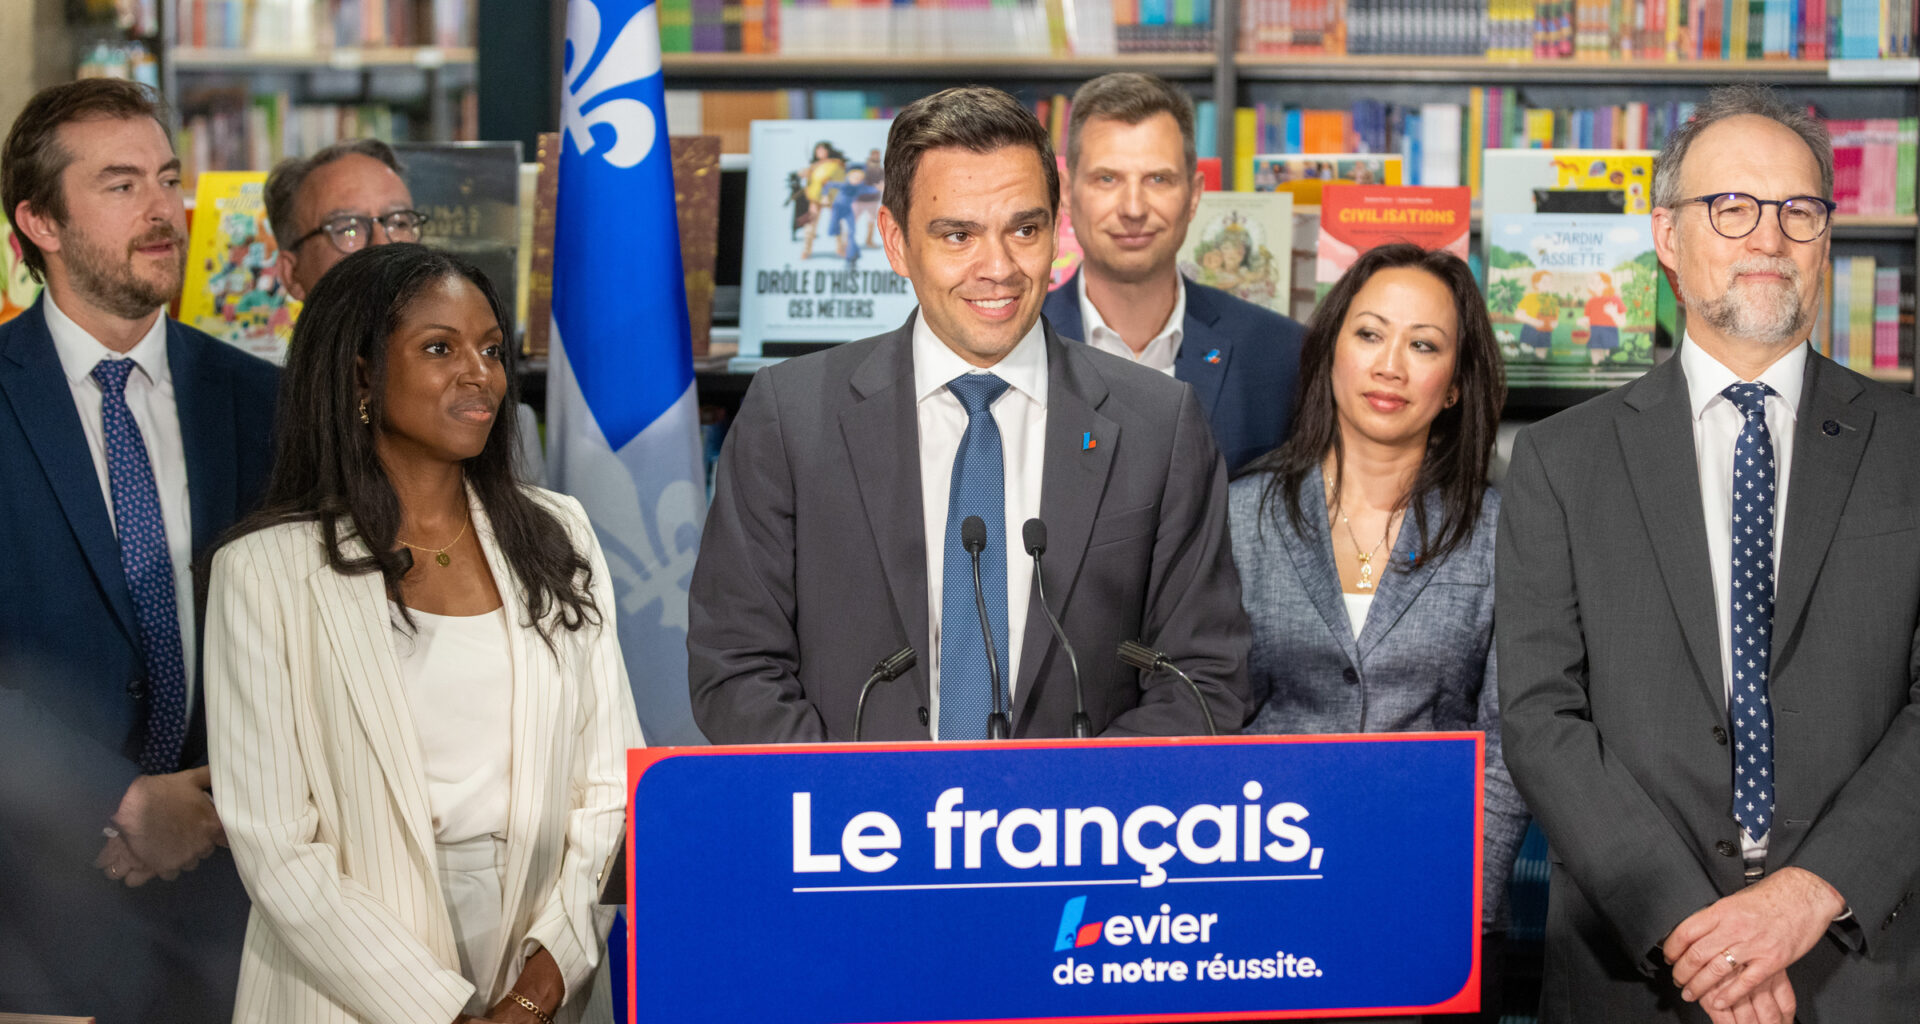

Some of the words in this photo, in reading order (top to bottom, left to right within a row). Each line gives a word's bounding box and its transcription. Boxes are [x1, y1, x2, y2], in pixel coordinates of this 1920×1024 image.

[1339, 208, 1455, 224] CIVILISATIONS
[1553, 231, 1604, 246] JARDIN
[1540, 252, 1606, 266] ASSIETTE
[757, 263, 810, 295] DRÔLE
[814, 269, 908, 295] D'HISTOIRE
[817, 295, 874, 319] MÉTIERS
[792, 792, 902, 873] Le
[926, 780, 1325, 888] français,
[1052, 957, 1095, 985] de
[1102, 957, 1189, 984] notre
[1196, 951, 1323, 982] réussite.
